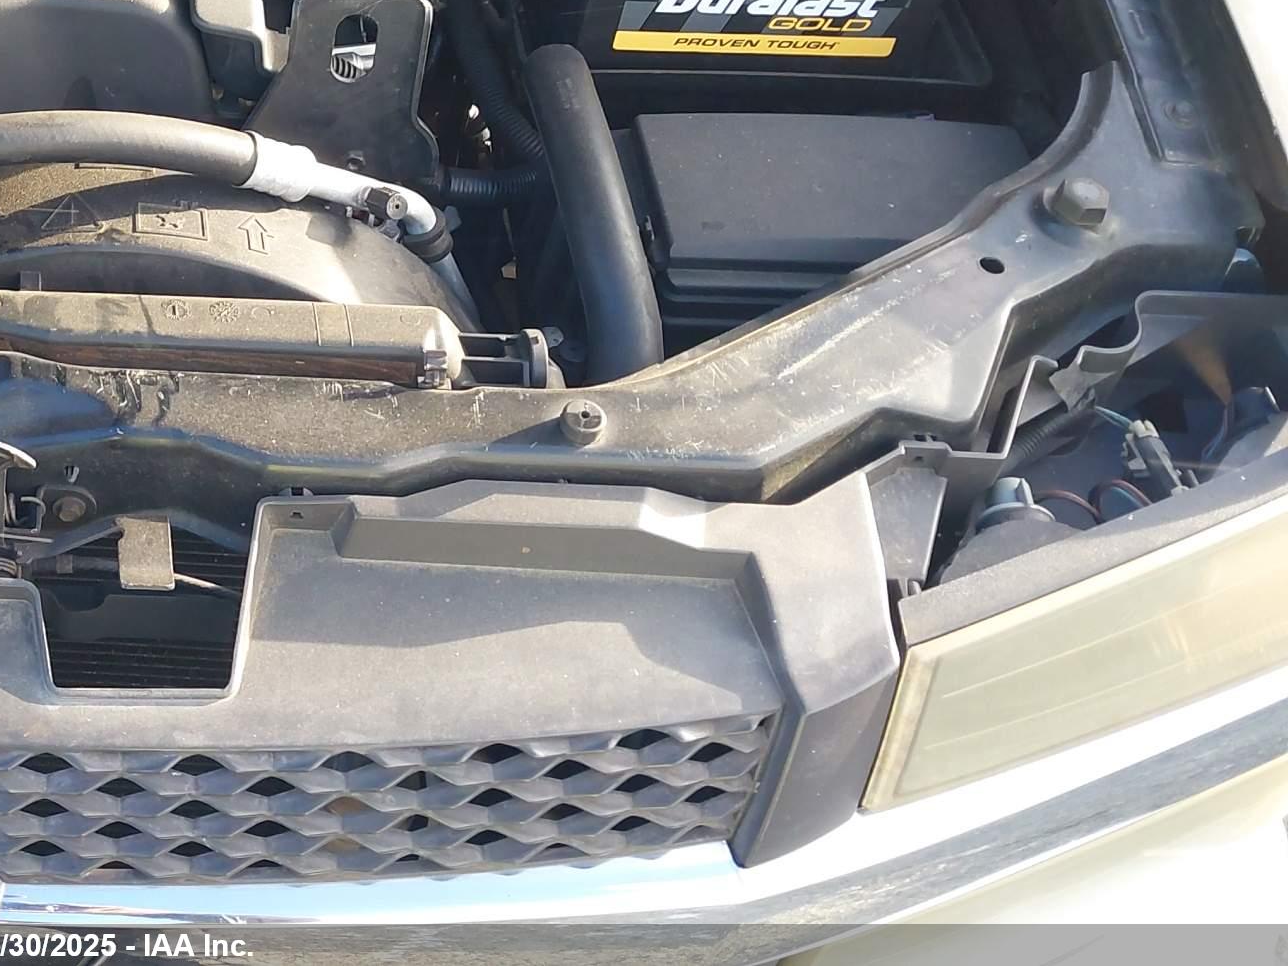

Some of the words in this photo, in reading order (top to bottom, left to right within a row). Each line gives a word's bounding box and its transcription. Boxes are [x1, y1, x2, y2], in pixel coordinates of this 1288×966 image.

[768, 17, 873, 32] GOLD
[673, 37, 760, 49] PROVEN
[767, 40, 838, 51] TOUGH
